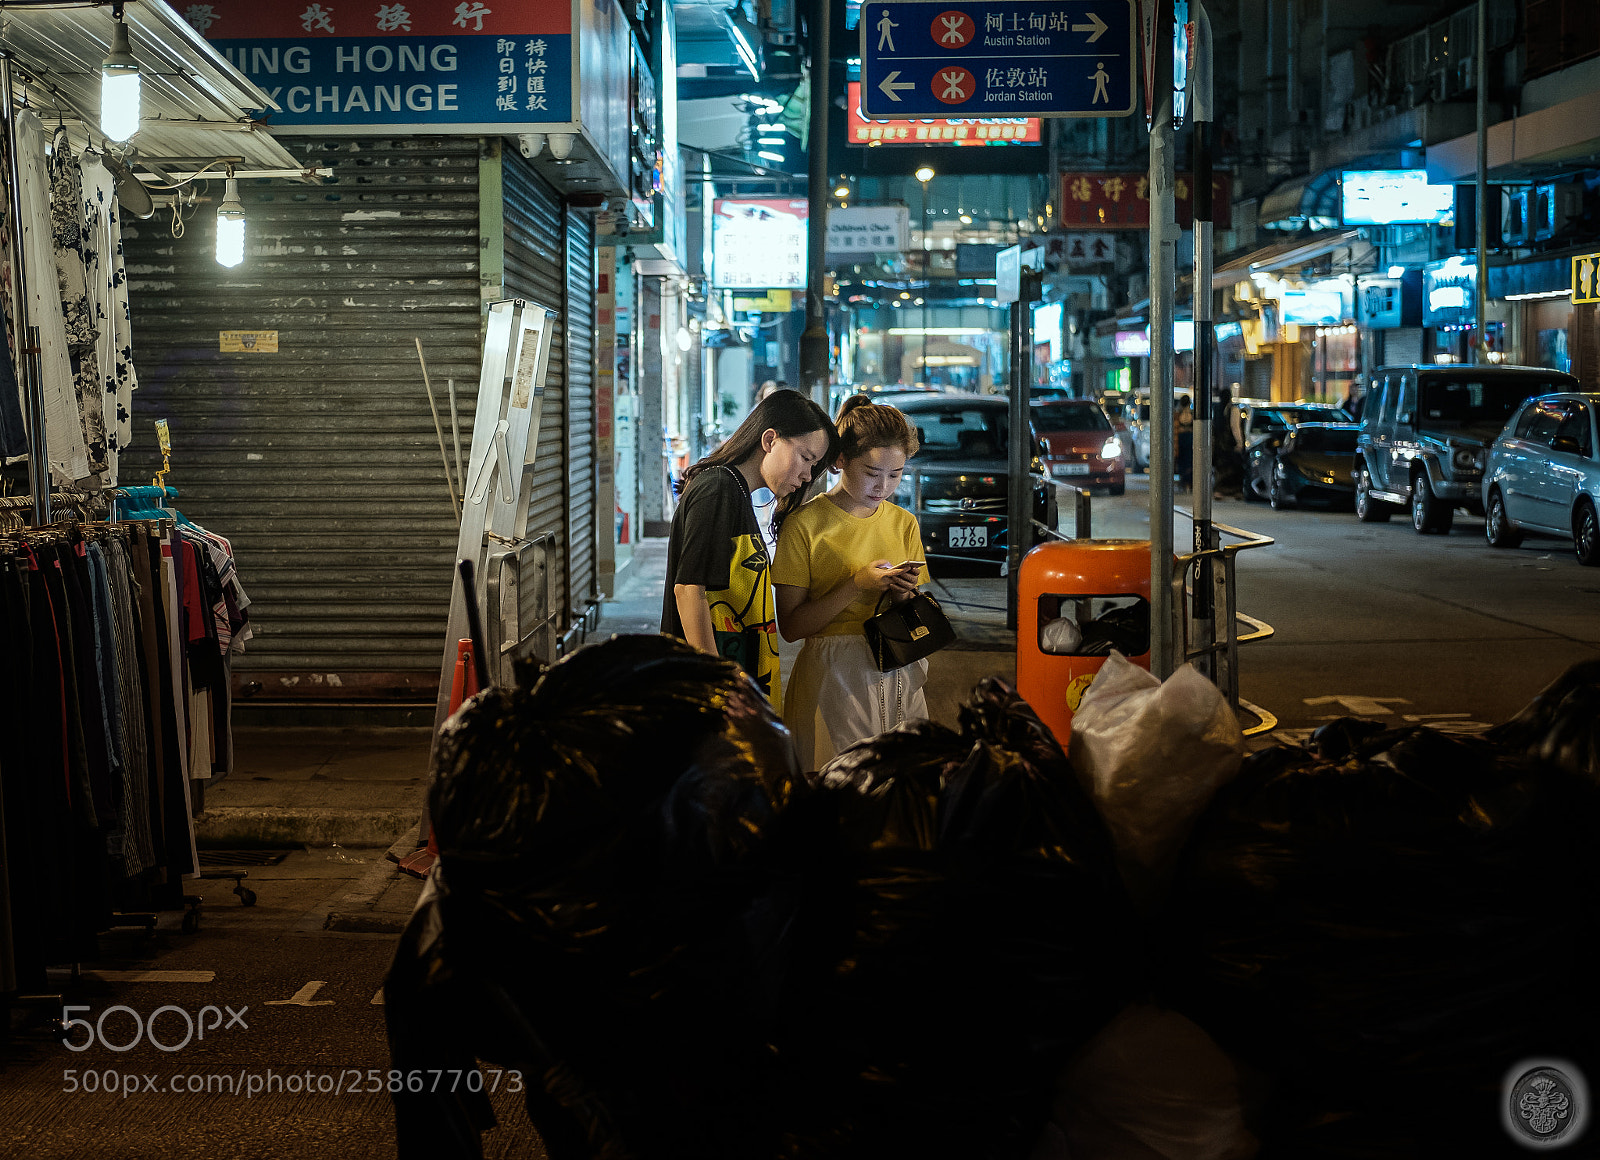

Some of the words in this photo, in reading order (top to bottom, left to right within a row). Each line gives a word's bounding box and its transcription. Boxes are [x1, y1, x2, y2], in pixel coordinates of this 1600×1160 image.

[984, 12, 1069, 33] 柯士甸站
[983, 35, 1014, 46] Austin
[1016, 35, 1051, 46] Station
[225, 47, 311, 74] ING
[336, 44, 458, 73] HONG
[495, 38, 519, 112] 即日到帳
[985, 67, 1048, 88] 佐敦站
[250, 84, 459, 114] XCHANGE
[983, 91, 1016, 102] Jordan
[1018, 91, 1053, 102] Station
[951, 537, 985, 547] 2769
[959, 527, 976, 537] TX
